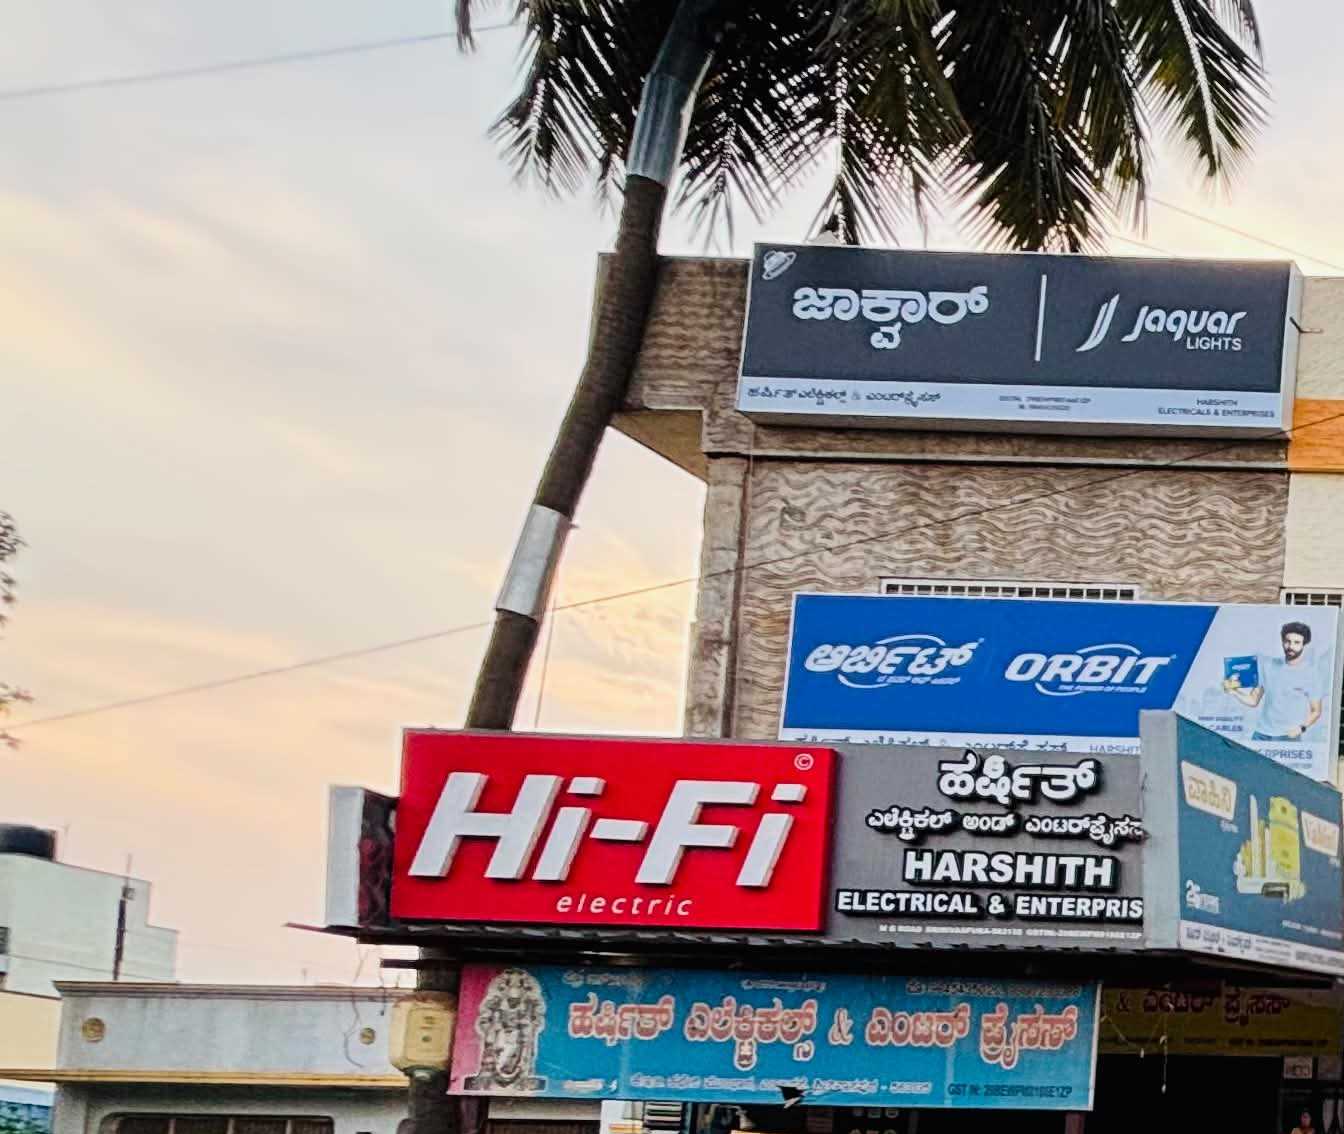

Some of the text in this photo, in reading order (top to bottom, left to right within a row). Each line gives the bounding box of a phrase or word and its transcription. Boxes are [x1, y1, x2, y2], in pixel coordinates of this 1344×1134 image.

[792, 285, 988, 349] ಜಾಕ್ವಾರ್
[1121, 304, 1248, 344] Jaquar
[1186, 338, 1242, 352] LIGHTS
[1158, 407, 1211, 416] ELECTRICALS
[1222, 410, 1275, 418] ENTERPRISES
[1004, 653, 1171, 684] ORBIT
[939, 751, 1095, 803] ಹರ್ಷಿತ್
[407, 771, 808, 887] Hi-Fi
[905, 851, 1113, 886] HARSHITH
[556, 894, 693, 916] electric
[838, 892, 978, 913] ELECTRICAL
[988, 895, 1005, 914] &
[828, 1008, 854, 1046] &
